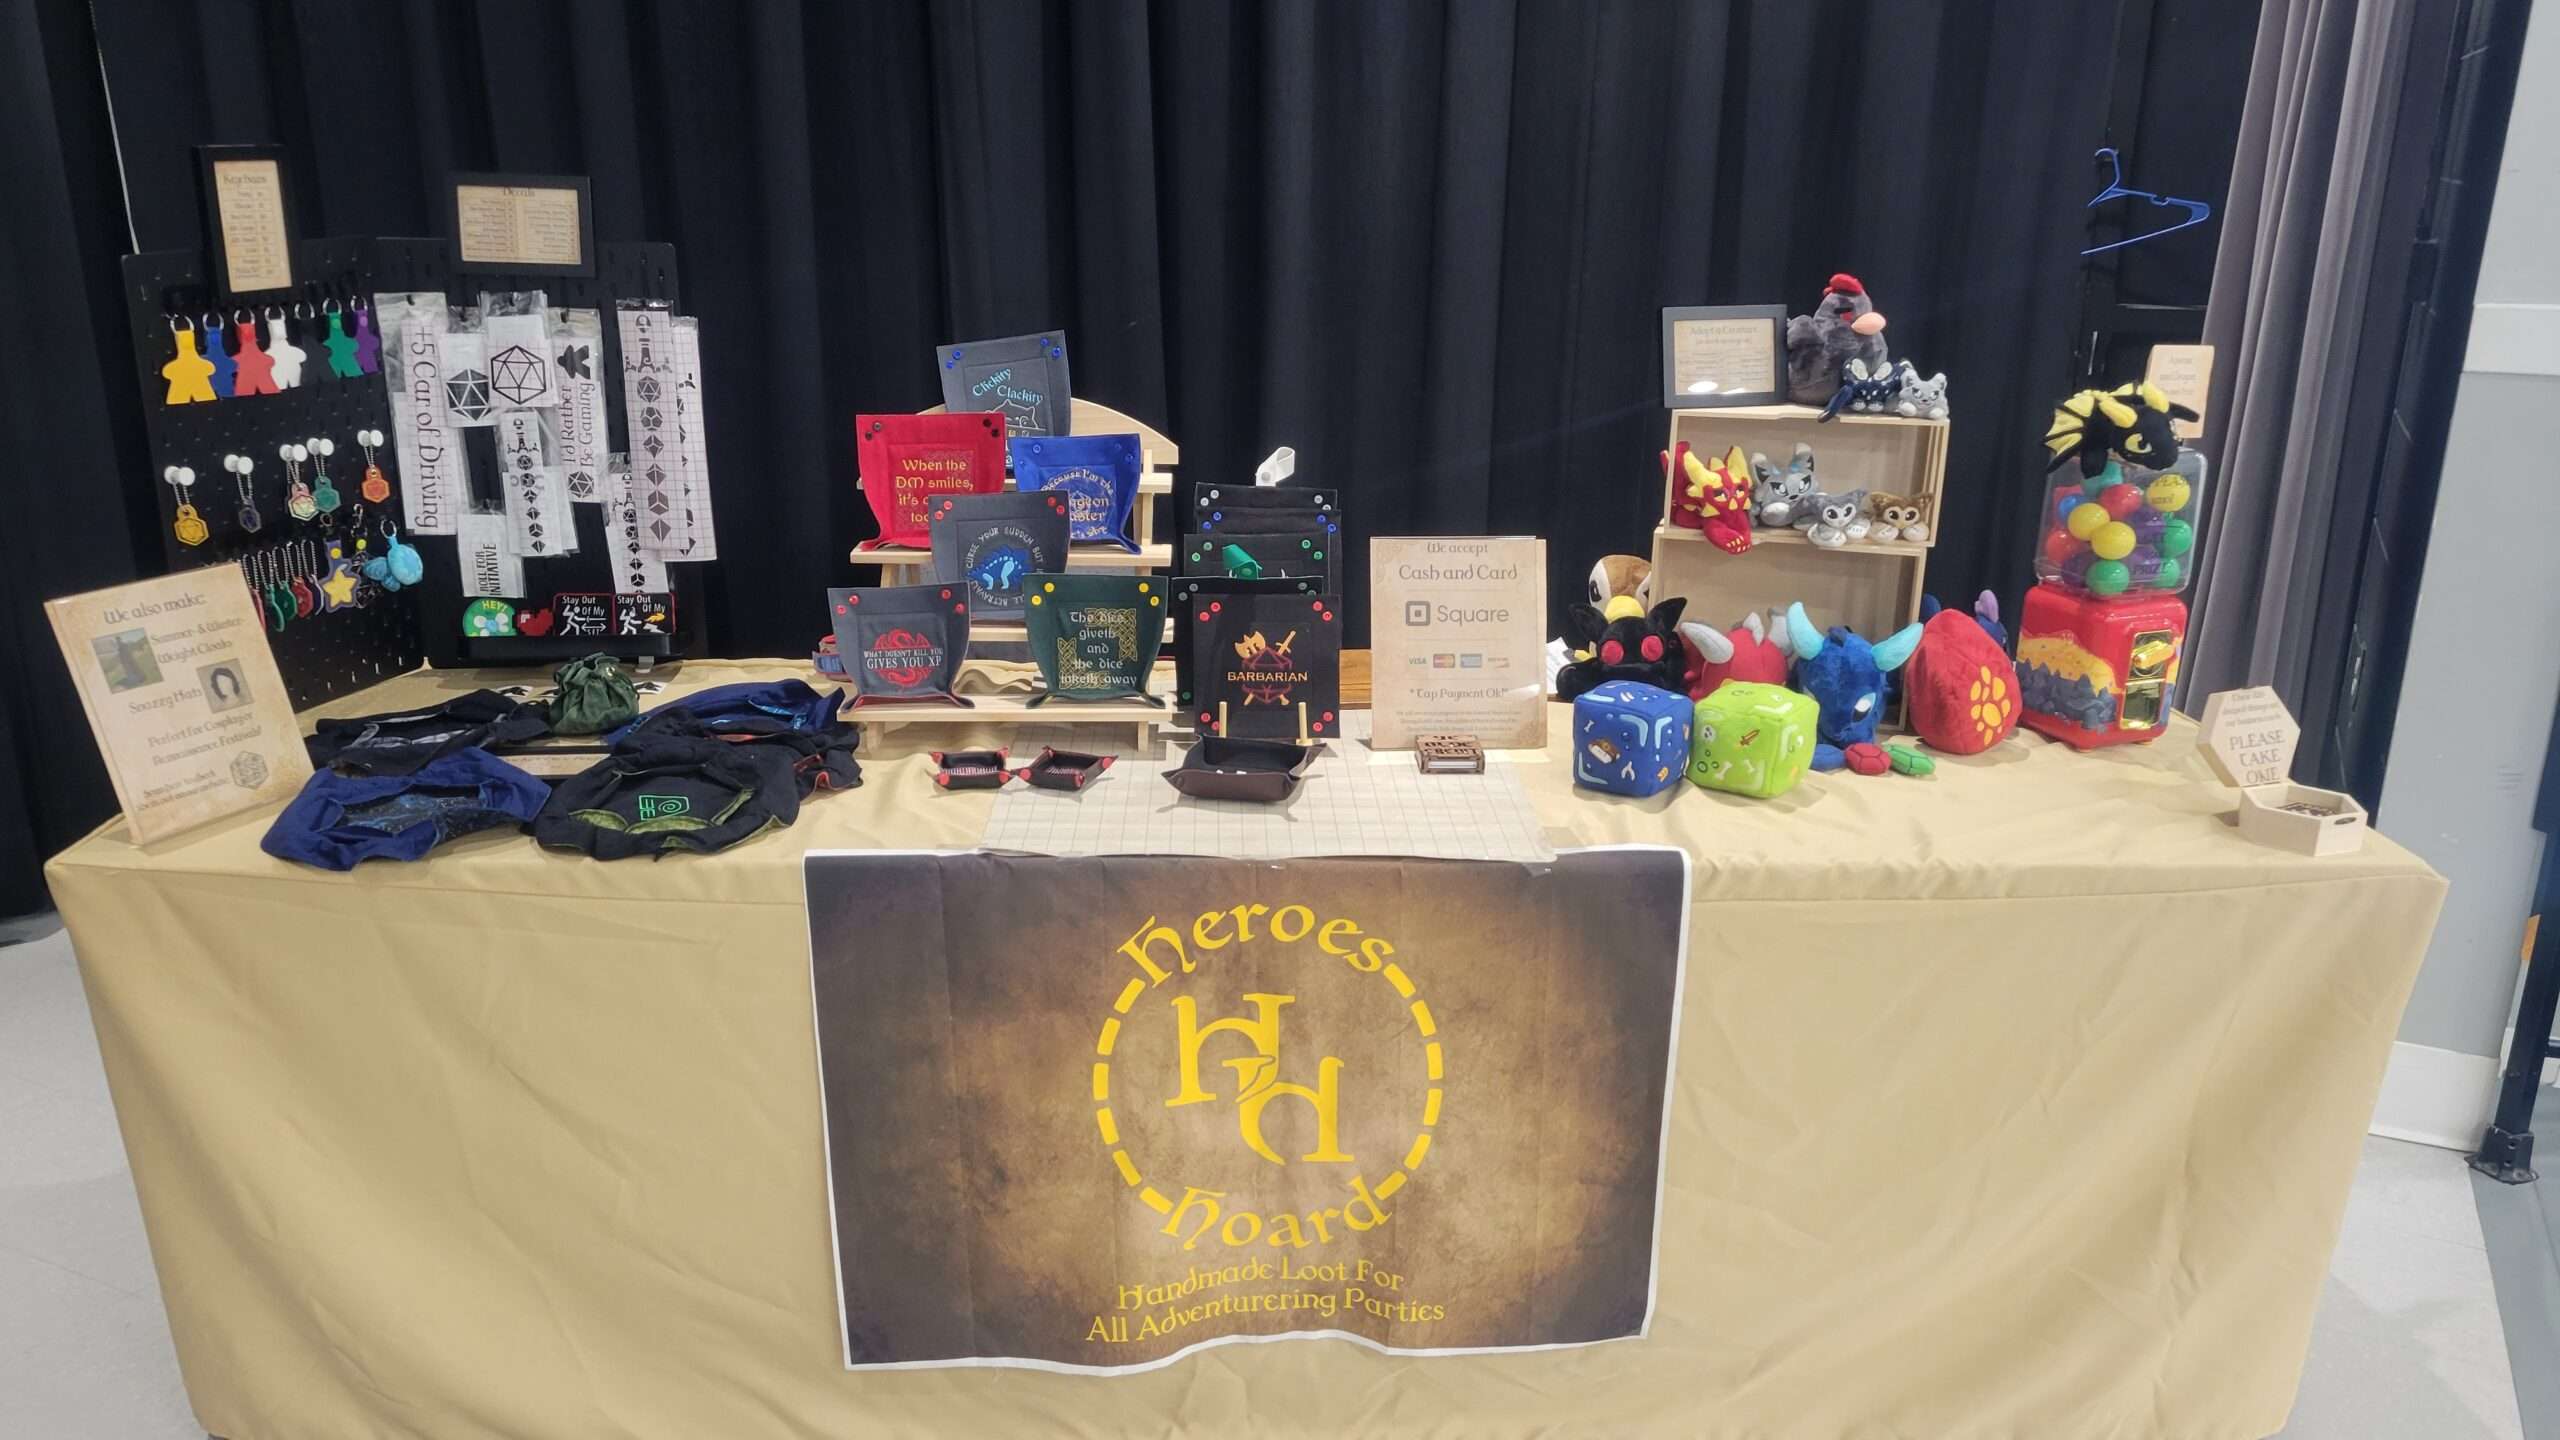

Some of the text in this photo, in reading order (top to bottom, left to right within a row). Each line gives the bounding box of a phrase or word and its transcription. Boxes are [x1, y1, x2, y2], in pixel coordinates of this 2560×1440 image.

[972, 368, 1011, 397] Clickity
[997, 385, 1043, 406] Clackity
[559, 385, 576, 442] Rather
[410, 327, 445, 528] +5 Car of Driving
[578, 383, 596, 467] Be Gaming
[902, 459, 967, 472] When the
[895, 476, 974, 492] DM smiles,
[898, 493, 920, 506] it's
[978, 527, 1000, 542] YOUR
[1004, 526, 1034, 545] SUDDEN
[1032, 546, 1044, 562] BUT
[1426, 542, 1488, 557] We accept
[483, 543, 500, 597] INITIATIVE
[1398, 563, 1518, 580] Cash and Card
[481, 600, 508, 613] HEY!
[562, 595, 596, 606] Stay Out
[617, 594, 651, 605] Stay Out
[104, 608, 131, 626] We
[132, 600, 163, 619] also
[581, 606, 605, 617] Of My
[642, 603, 666, 613] Of My
[1069, 611, 1093, 623] The
[1437, 605, 1509, 627] Square
[1079, 627, 1116, 640] giveth
[863, 647, 944, 658] WHAT DOESN'T KILL YOU
[1086, 642, 1109, 654] and
[866, 655, 942, 669] GIVES YOU XP
[1073, 657, 1124, 669] the dice
[1408, 657, 1427, 665] VISA
[1103, 674, 1137, 687] away
[1227, 670, 1308, 684] BARBARIAN
[1440, 688, 1484, 702] Payment
[2229, 729, 2285, 750] PLEASE
[2240, 748, 2280, 767] TAKE
[2246, 767, 2280, 784] ONE
[1118, 1256, 1404, 1312] Handmade Loot For
[1086, 1288, 1446, 1342] All Adventurering Parties
